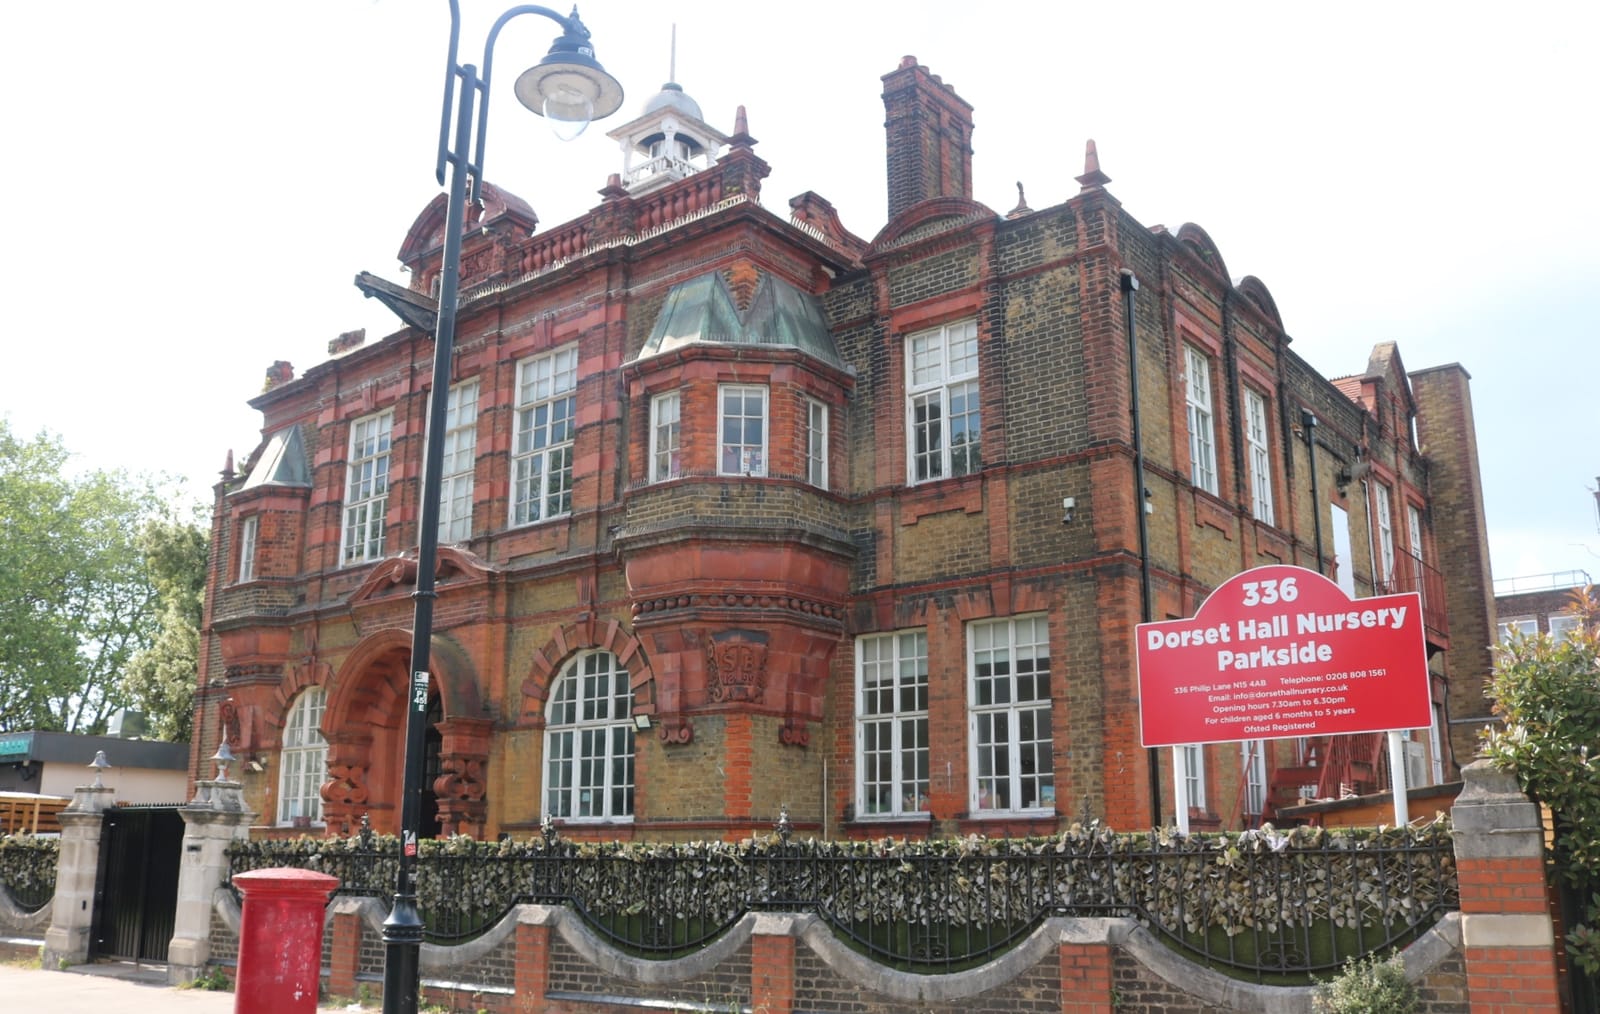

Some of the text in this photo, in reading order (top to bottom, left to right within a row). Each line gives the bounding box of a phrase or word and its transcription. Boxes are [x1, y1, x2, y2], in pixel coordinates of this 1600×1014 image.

[1242, 577, 1299, 607] 336
[1147, 606, 1408, 651] Dorset Hall Nursery
[1217, 640, 1333, 671] Parkside
[1190, 685, 1211, 693] Philip
[1212, 683, 1231, 691] Lane
[1233, 681, 1248, 689] N15
[1280, 675, 1324, 685] Telephone:
[1325, 672, 1348, 681] 0208
[1350, 671, 1367, 679] 808
[1368, 669, 1387, 677] 1561
[1208, 684, 1348, 702] Email: info@dorsethallnursery.co.uk
[1205, 706, 1356, 725] For children aged 6 months to 5 years
[1212, 696, 1346, 714] Opening hours 7.30am to 6.30pm
[1243, 721, 1317, 733] Ofsted Registered
